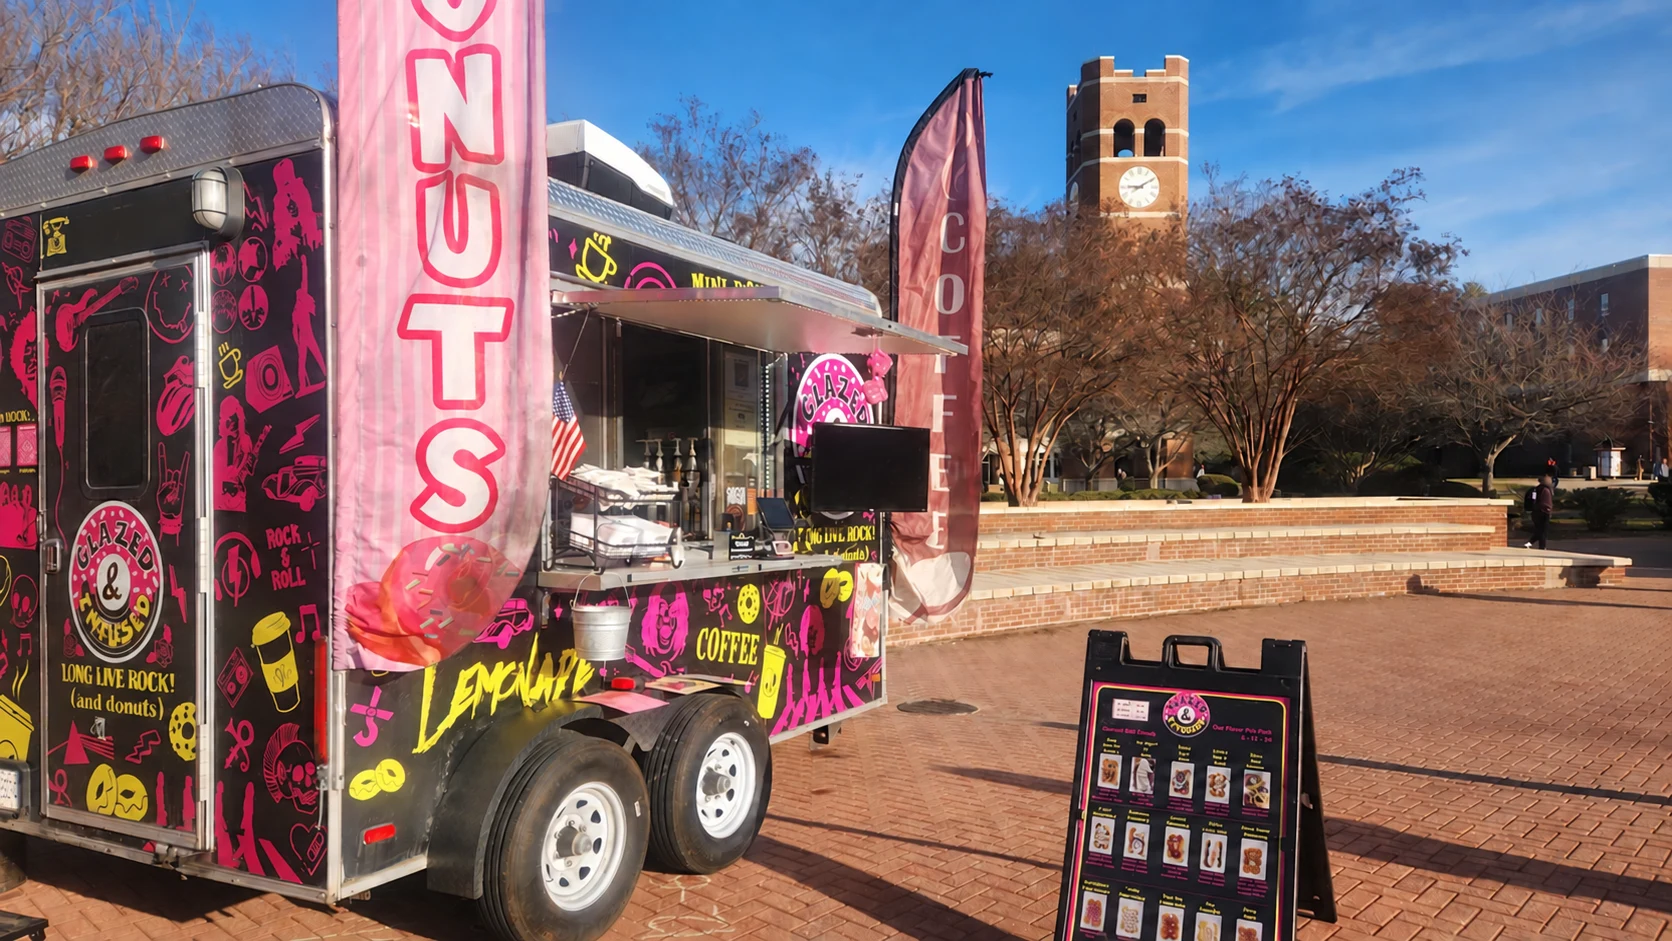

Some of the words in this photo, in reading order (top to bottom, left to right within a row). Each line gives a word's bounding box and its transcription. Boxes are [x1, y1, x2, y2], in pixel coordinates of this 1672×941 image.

[801, 373, 868, 423] GLAZED
[76, 520, 155, 571] GLAZED
[265, 523, 302, 550] ROCK
[846, 525, 876, 542] ROCK!
[281, 546, 291, 568] &
[102, 561, 122, 600] &
[271, 566, 307, 591] ROLL
[696, 627, 761, 666] COFFEE
[61, 663, 93, 685] LONG
[96, 666, 126, 689] LIVE
[128, 669, 176, 694] ROCK!
[70, 687, 102, 711] (and
[106, 695, 165, 721] donuts)
